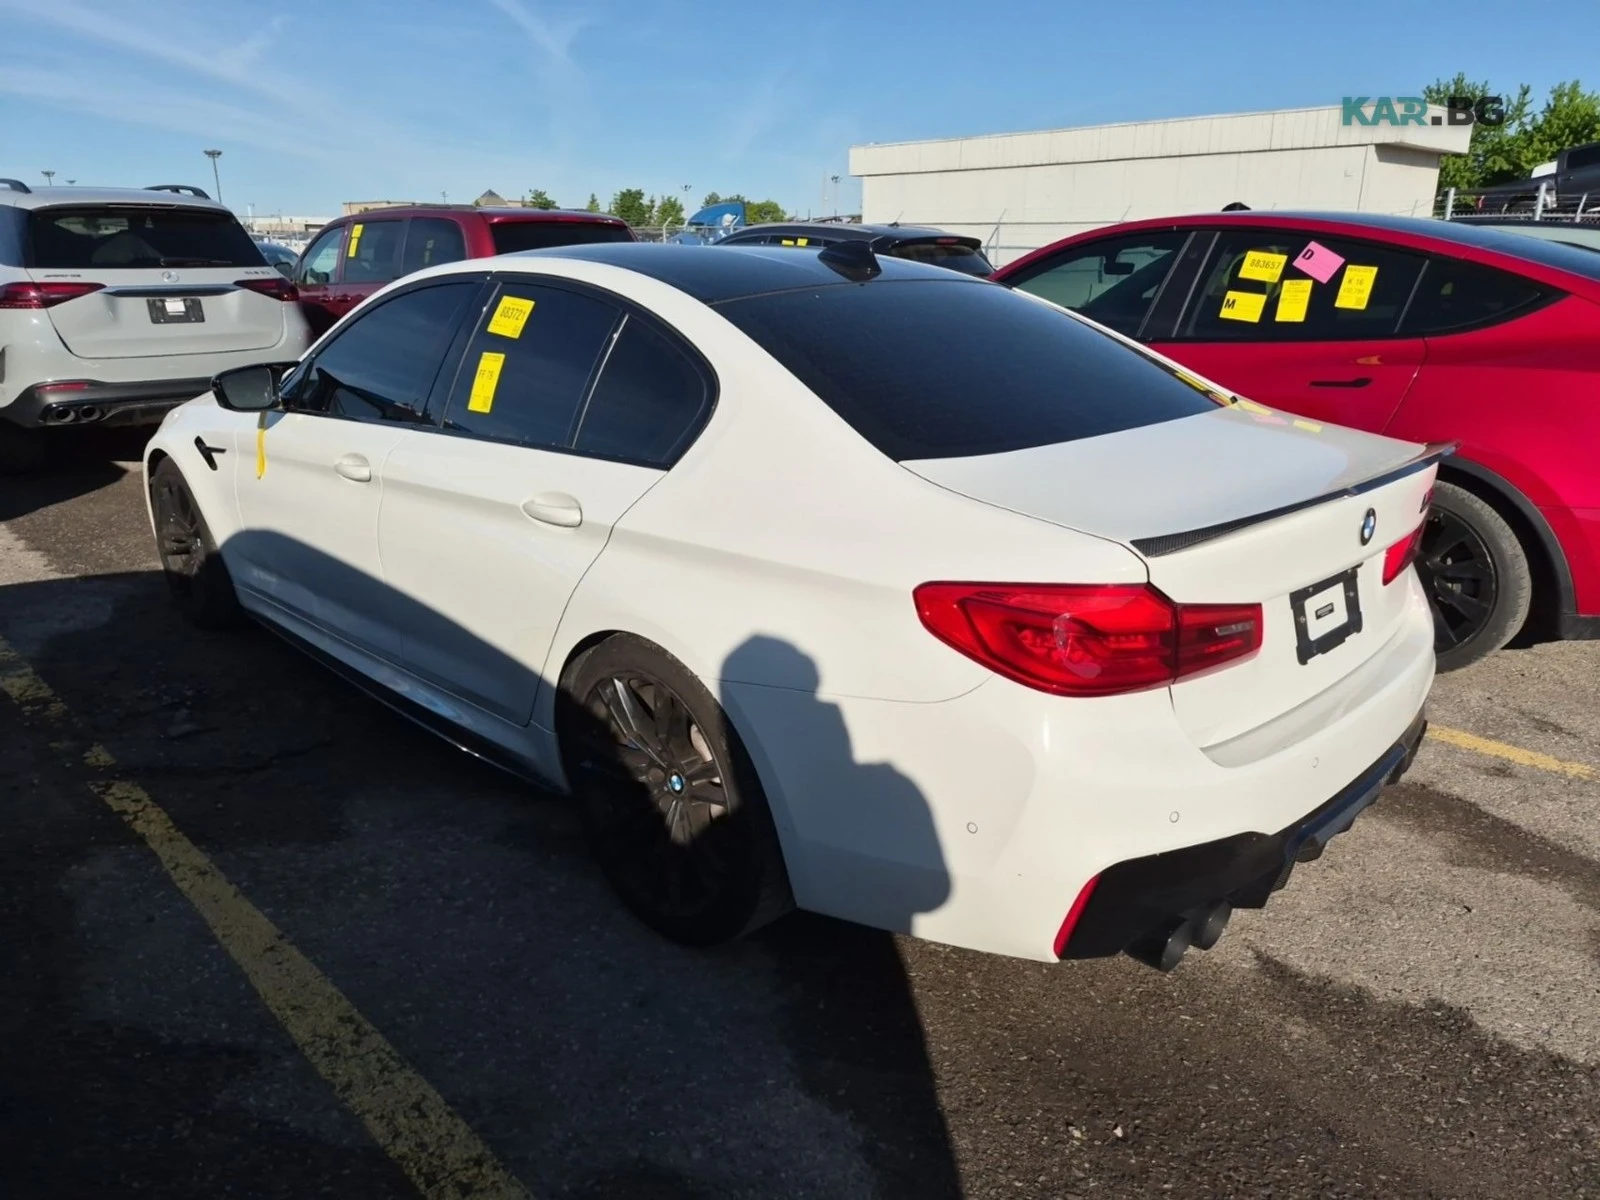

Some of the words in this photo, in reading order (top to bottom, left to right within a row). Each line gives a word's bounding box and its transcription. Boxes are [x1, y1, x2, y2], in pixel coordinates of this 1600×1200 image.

[1302, 248, 1314, 261] D
[1250, 258, 1282, 270] 883657
[1224, 298, 1236, 310] M
